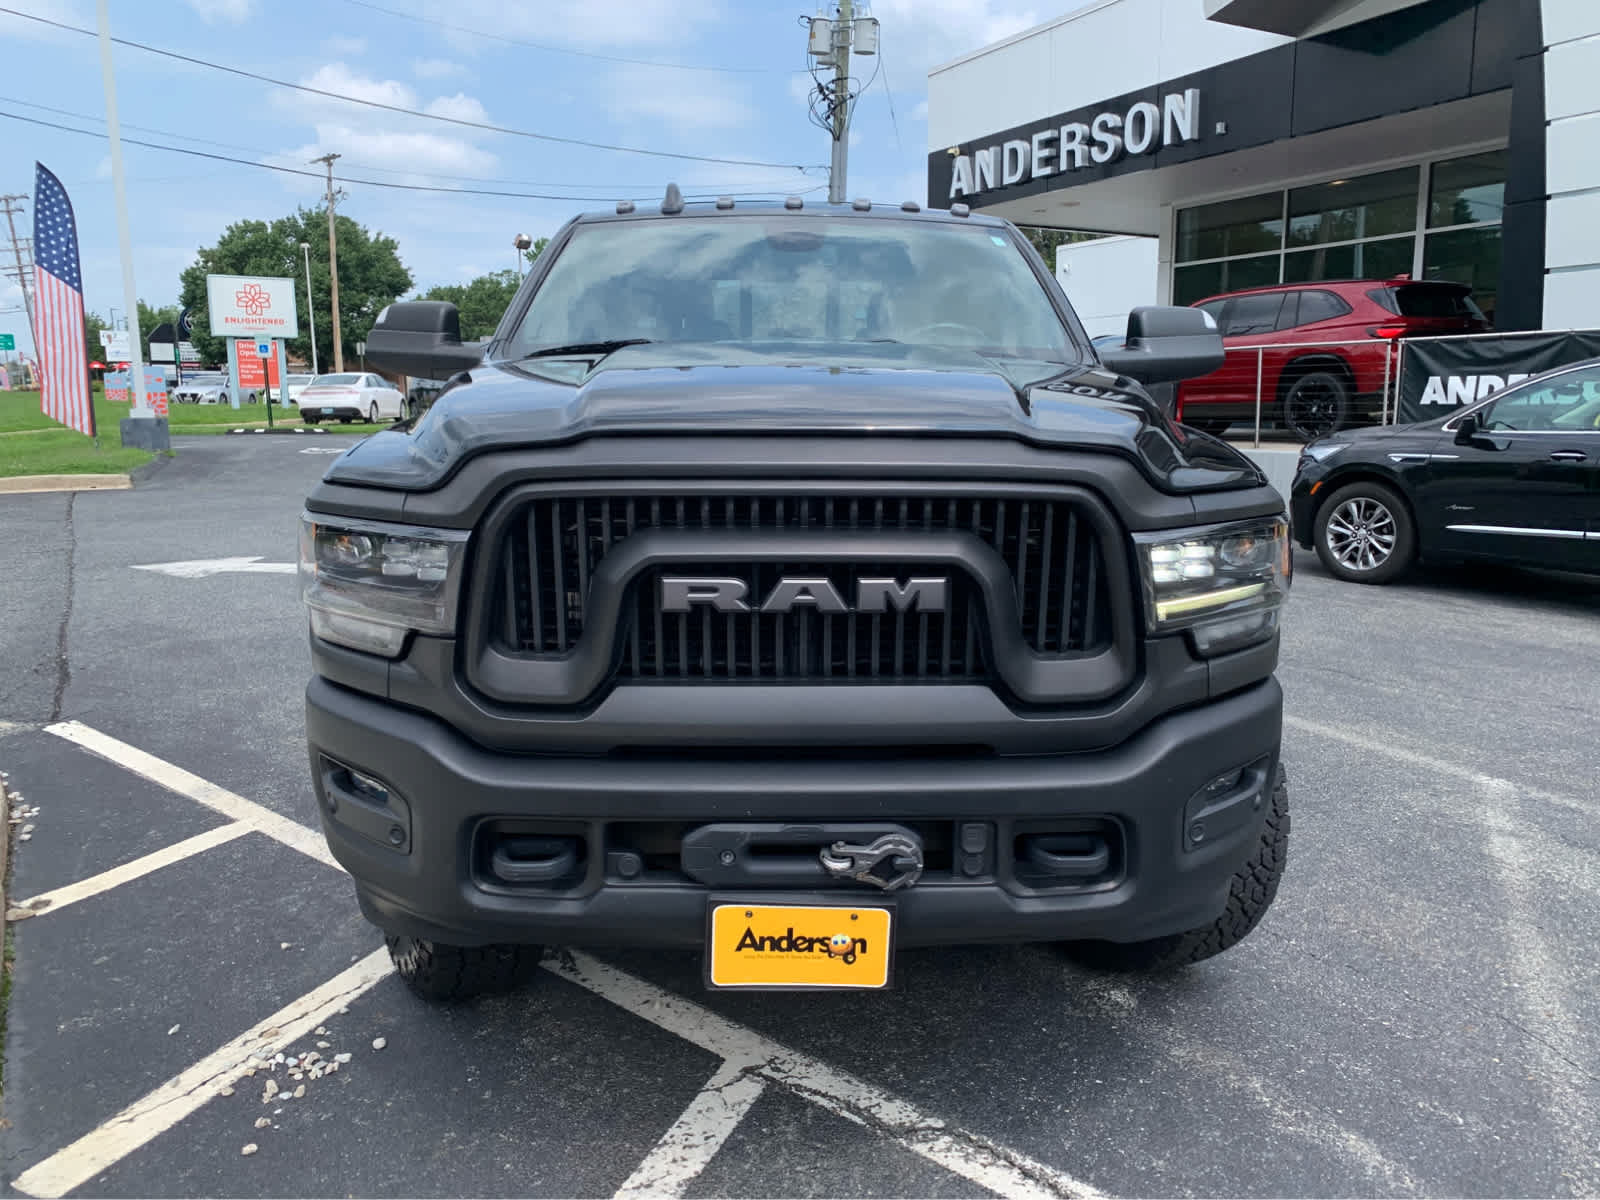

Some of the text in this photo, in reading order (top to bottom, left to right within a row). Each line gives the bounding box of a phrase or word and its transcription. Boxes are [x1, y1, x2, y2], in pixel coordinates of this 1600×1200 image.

[949, 87, 1200, 199] ANDERSON
[224, 316, 285, 326] ENLIGHTENED
[661, 576, 947, 613] RAM
[734, 926, 868, 955] Anderson
